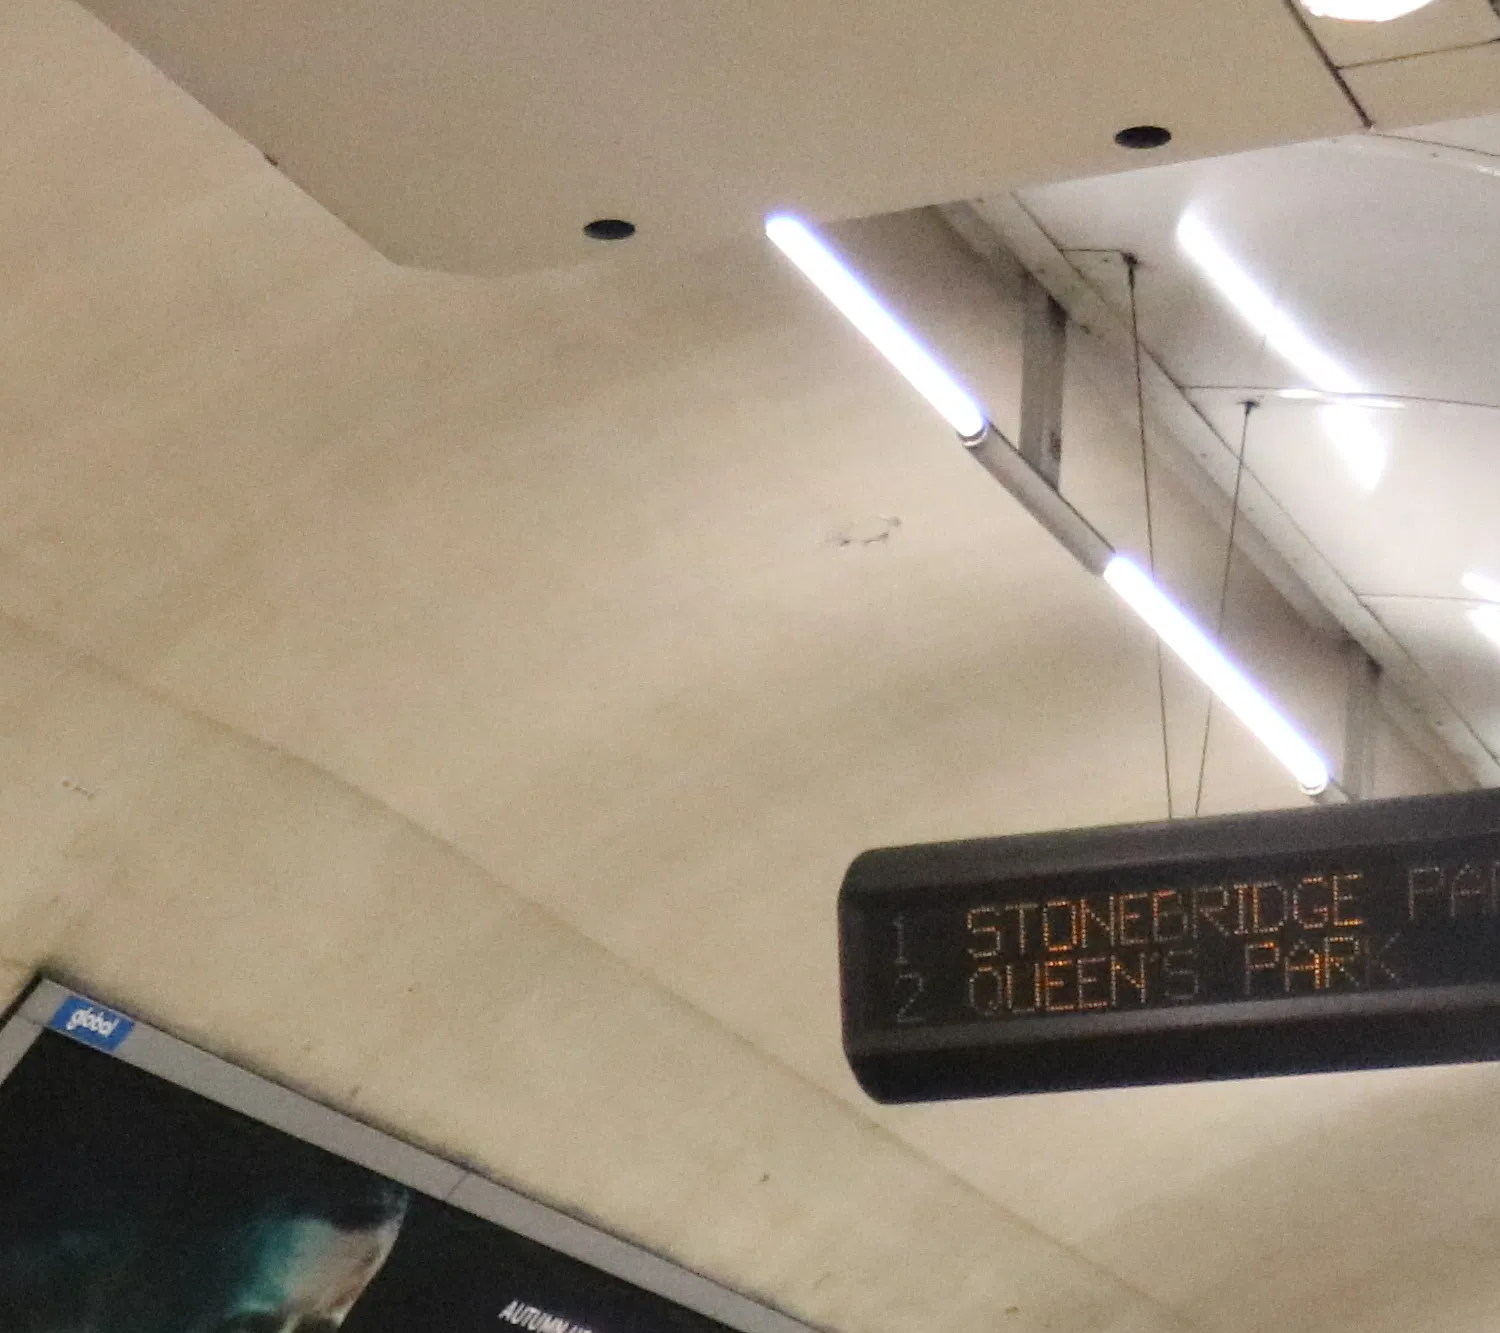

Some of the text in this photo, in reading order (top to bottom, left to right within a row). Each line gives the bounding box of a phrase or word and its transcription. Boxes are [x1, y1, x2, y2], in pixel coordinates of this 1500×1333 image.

[966, 871, 1365, 960] STONEBRIDGE
[896, 971, 925, 1022] 2
[968, 946, 1200, 1017] QUEEN'S
[1245, 932, 1400, 996] PARK
